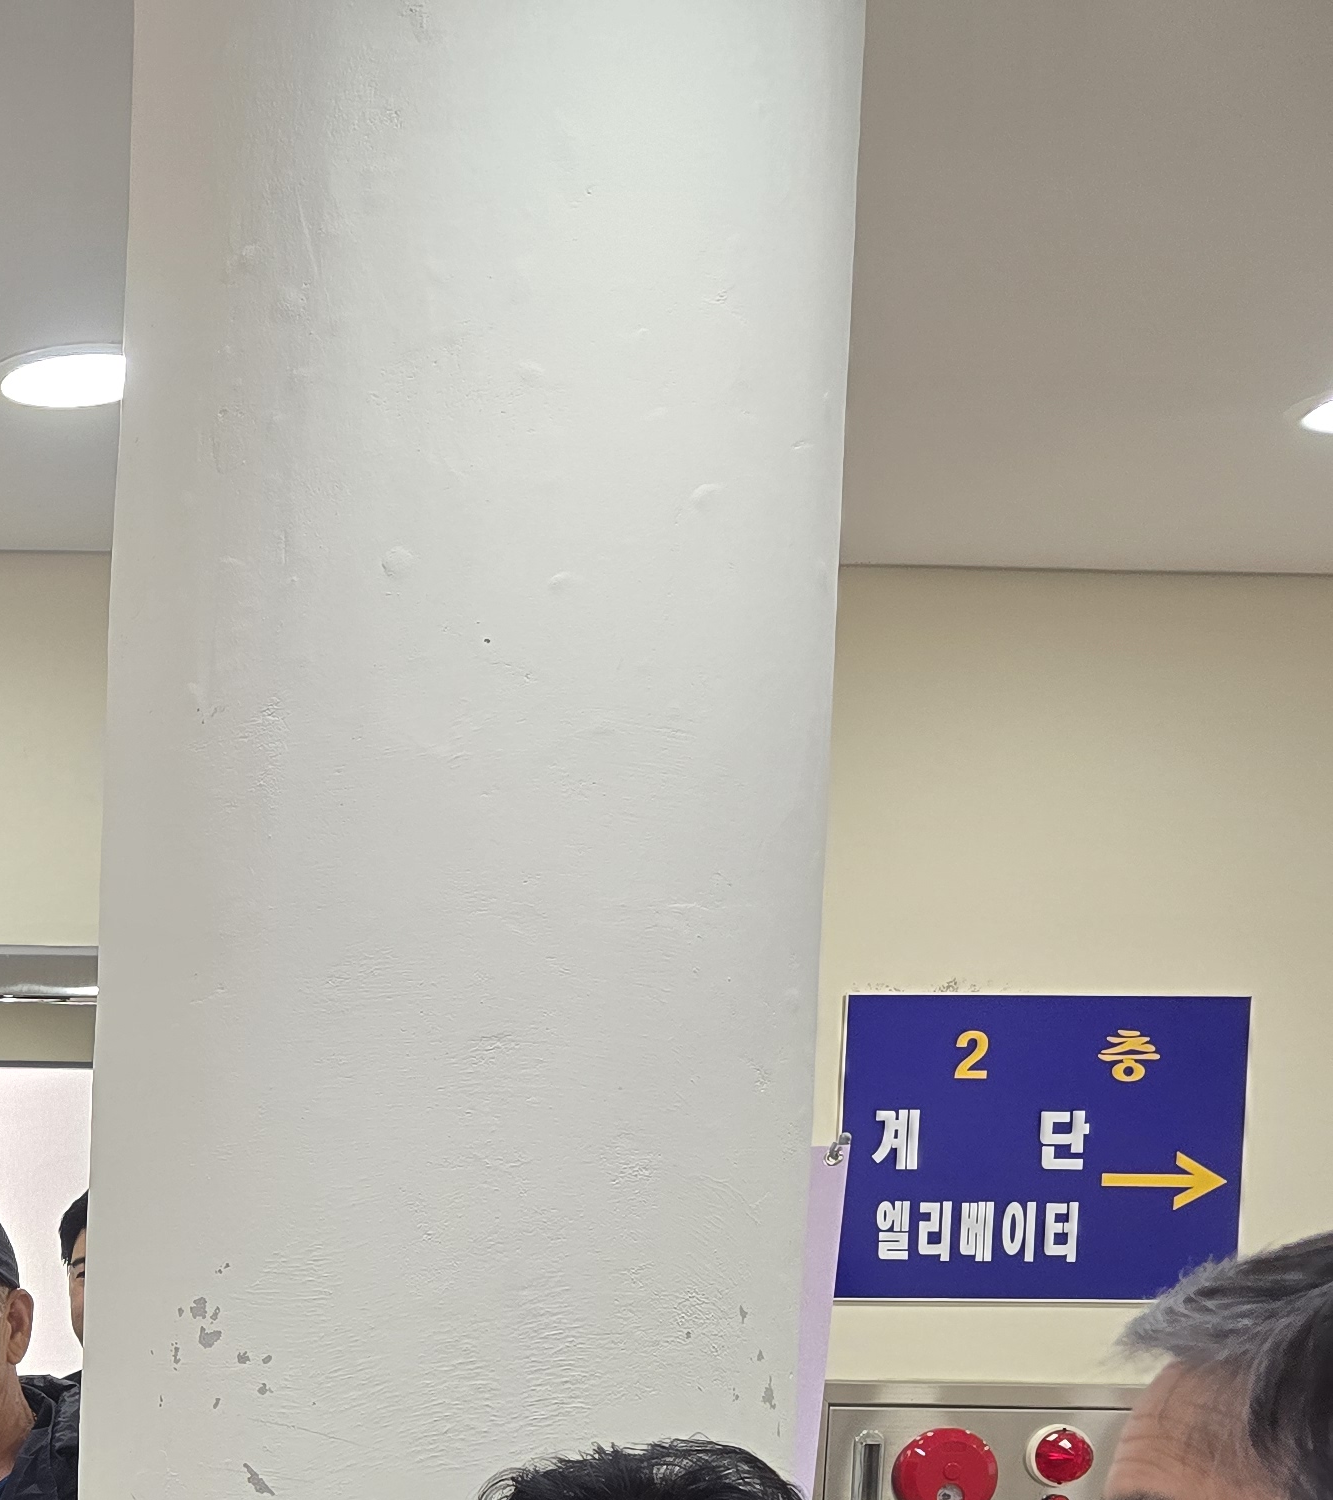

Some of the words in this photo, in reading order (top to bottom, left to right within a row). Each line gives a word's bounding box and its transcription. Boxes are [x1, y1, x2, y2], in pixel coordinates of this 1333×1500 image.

[954, 1030, 990, 1080] 2
[1097, 1029, 1161, 1082] 층
[876, 1200, 1080, 1263] 엘리베이터
